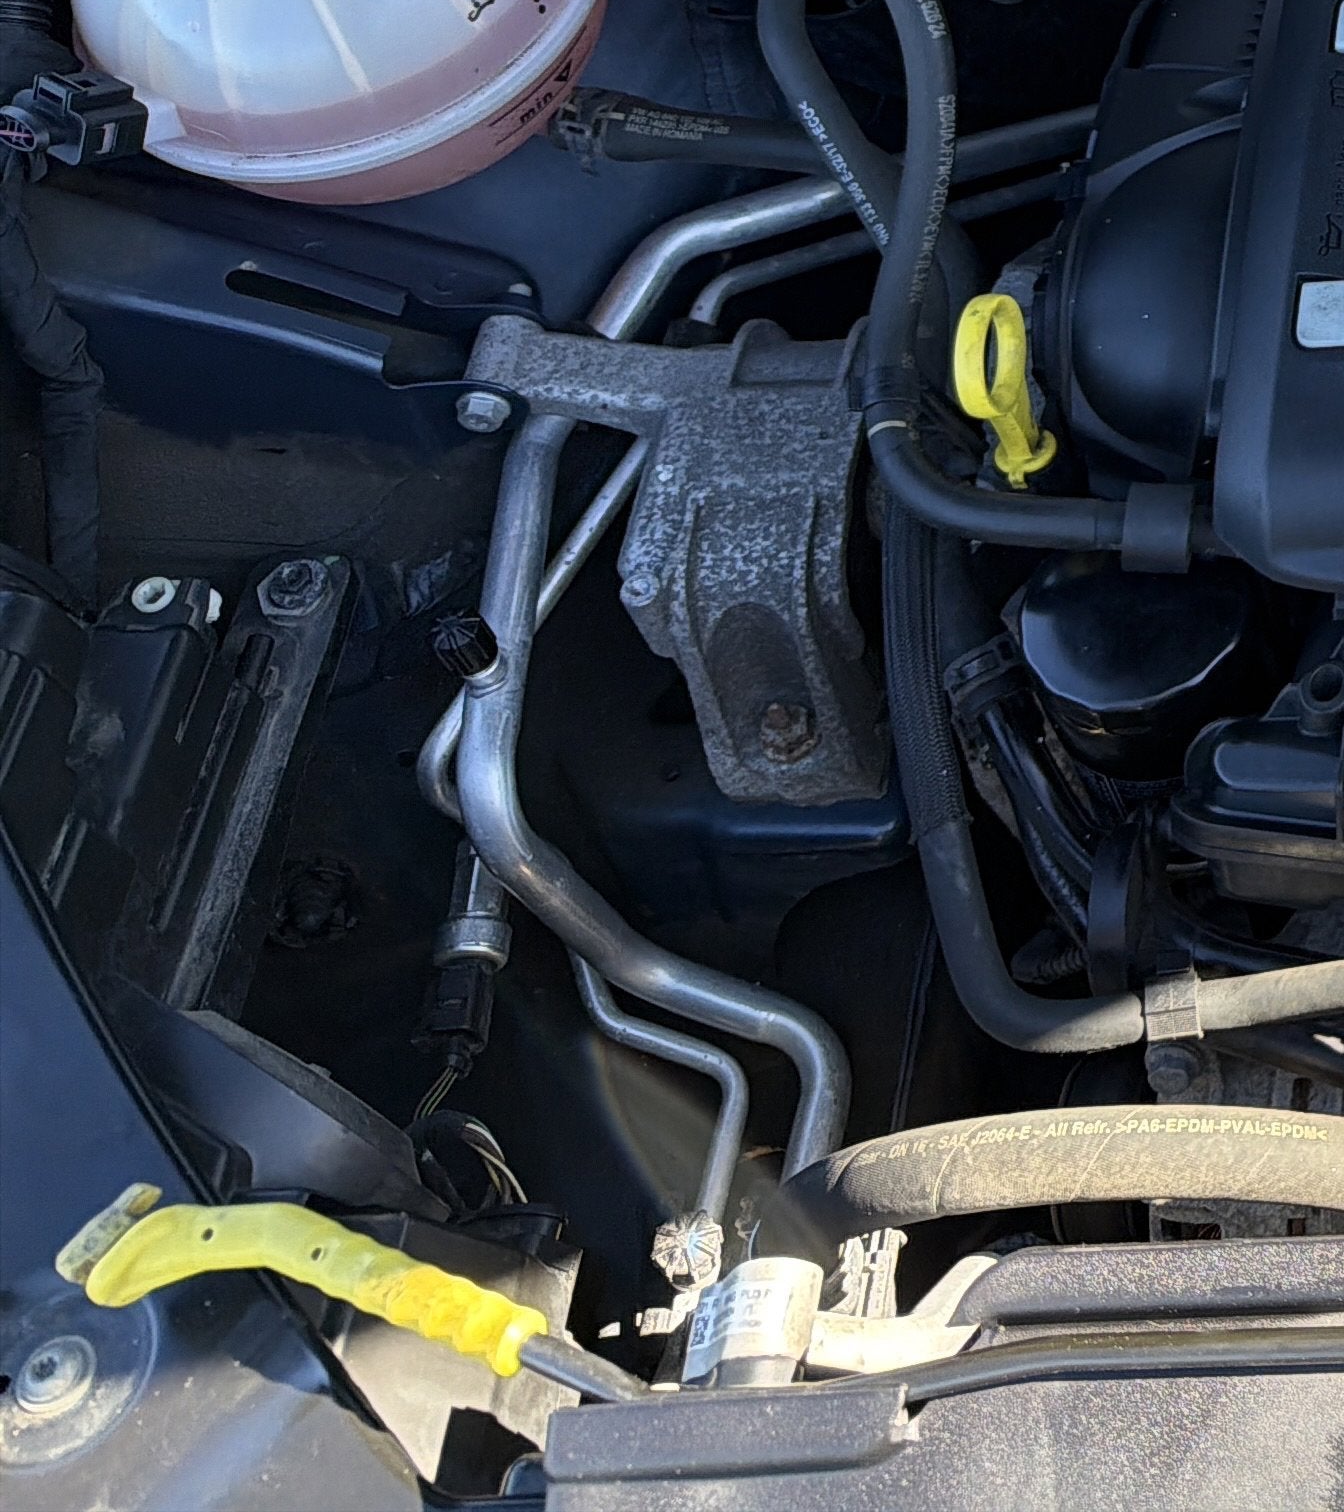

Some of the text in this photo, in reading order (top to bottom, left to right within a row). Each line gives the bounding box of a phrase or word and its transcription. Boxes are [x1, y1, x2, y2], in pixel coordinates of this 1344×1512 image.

[519, 90, 555, 126] min
[971, 1124, 1032, 1144] J2064-E
[1045, 1122, 1069, 1138] All
[1071, 1120, 1111, 1136] Refr.
